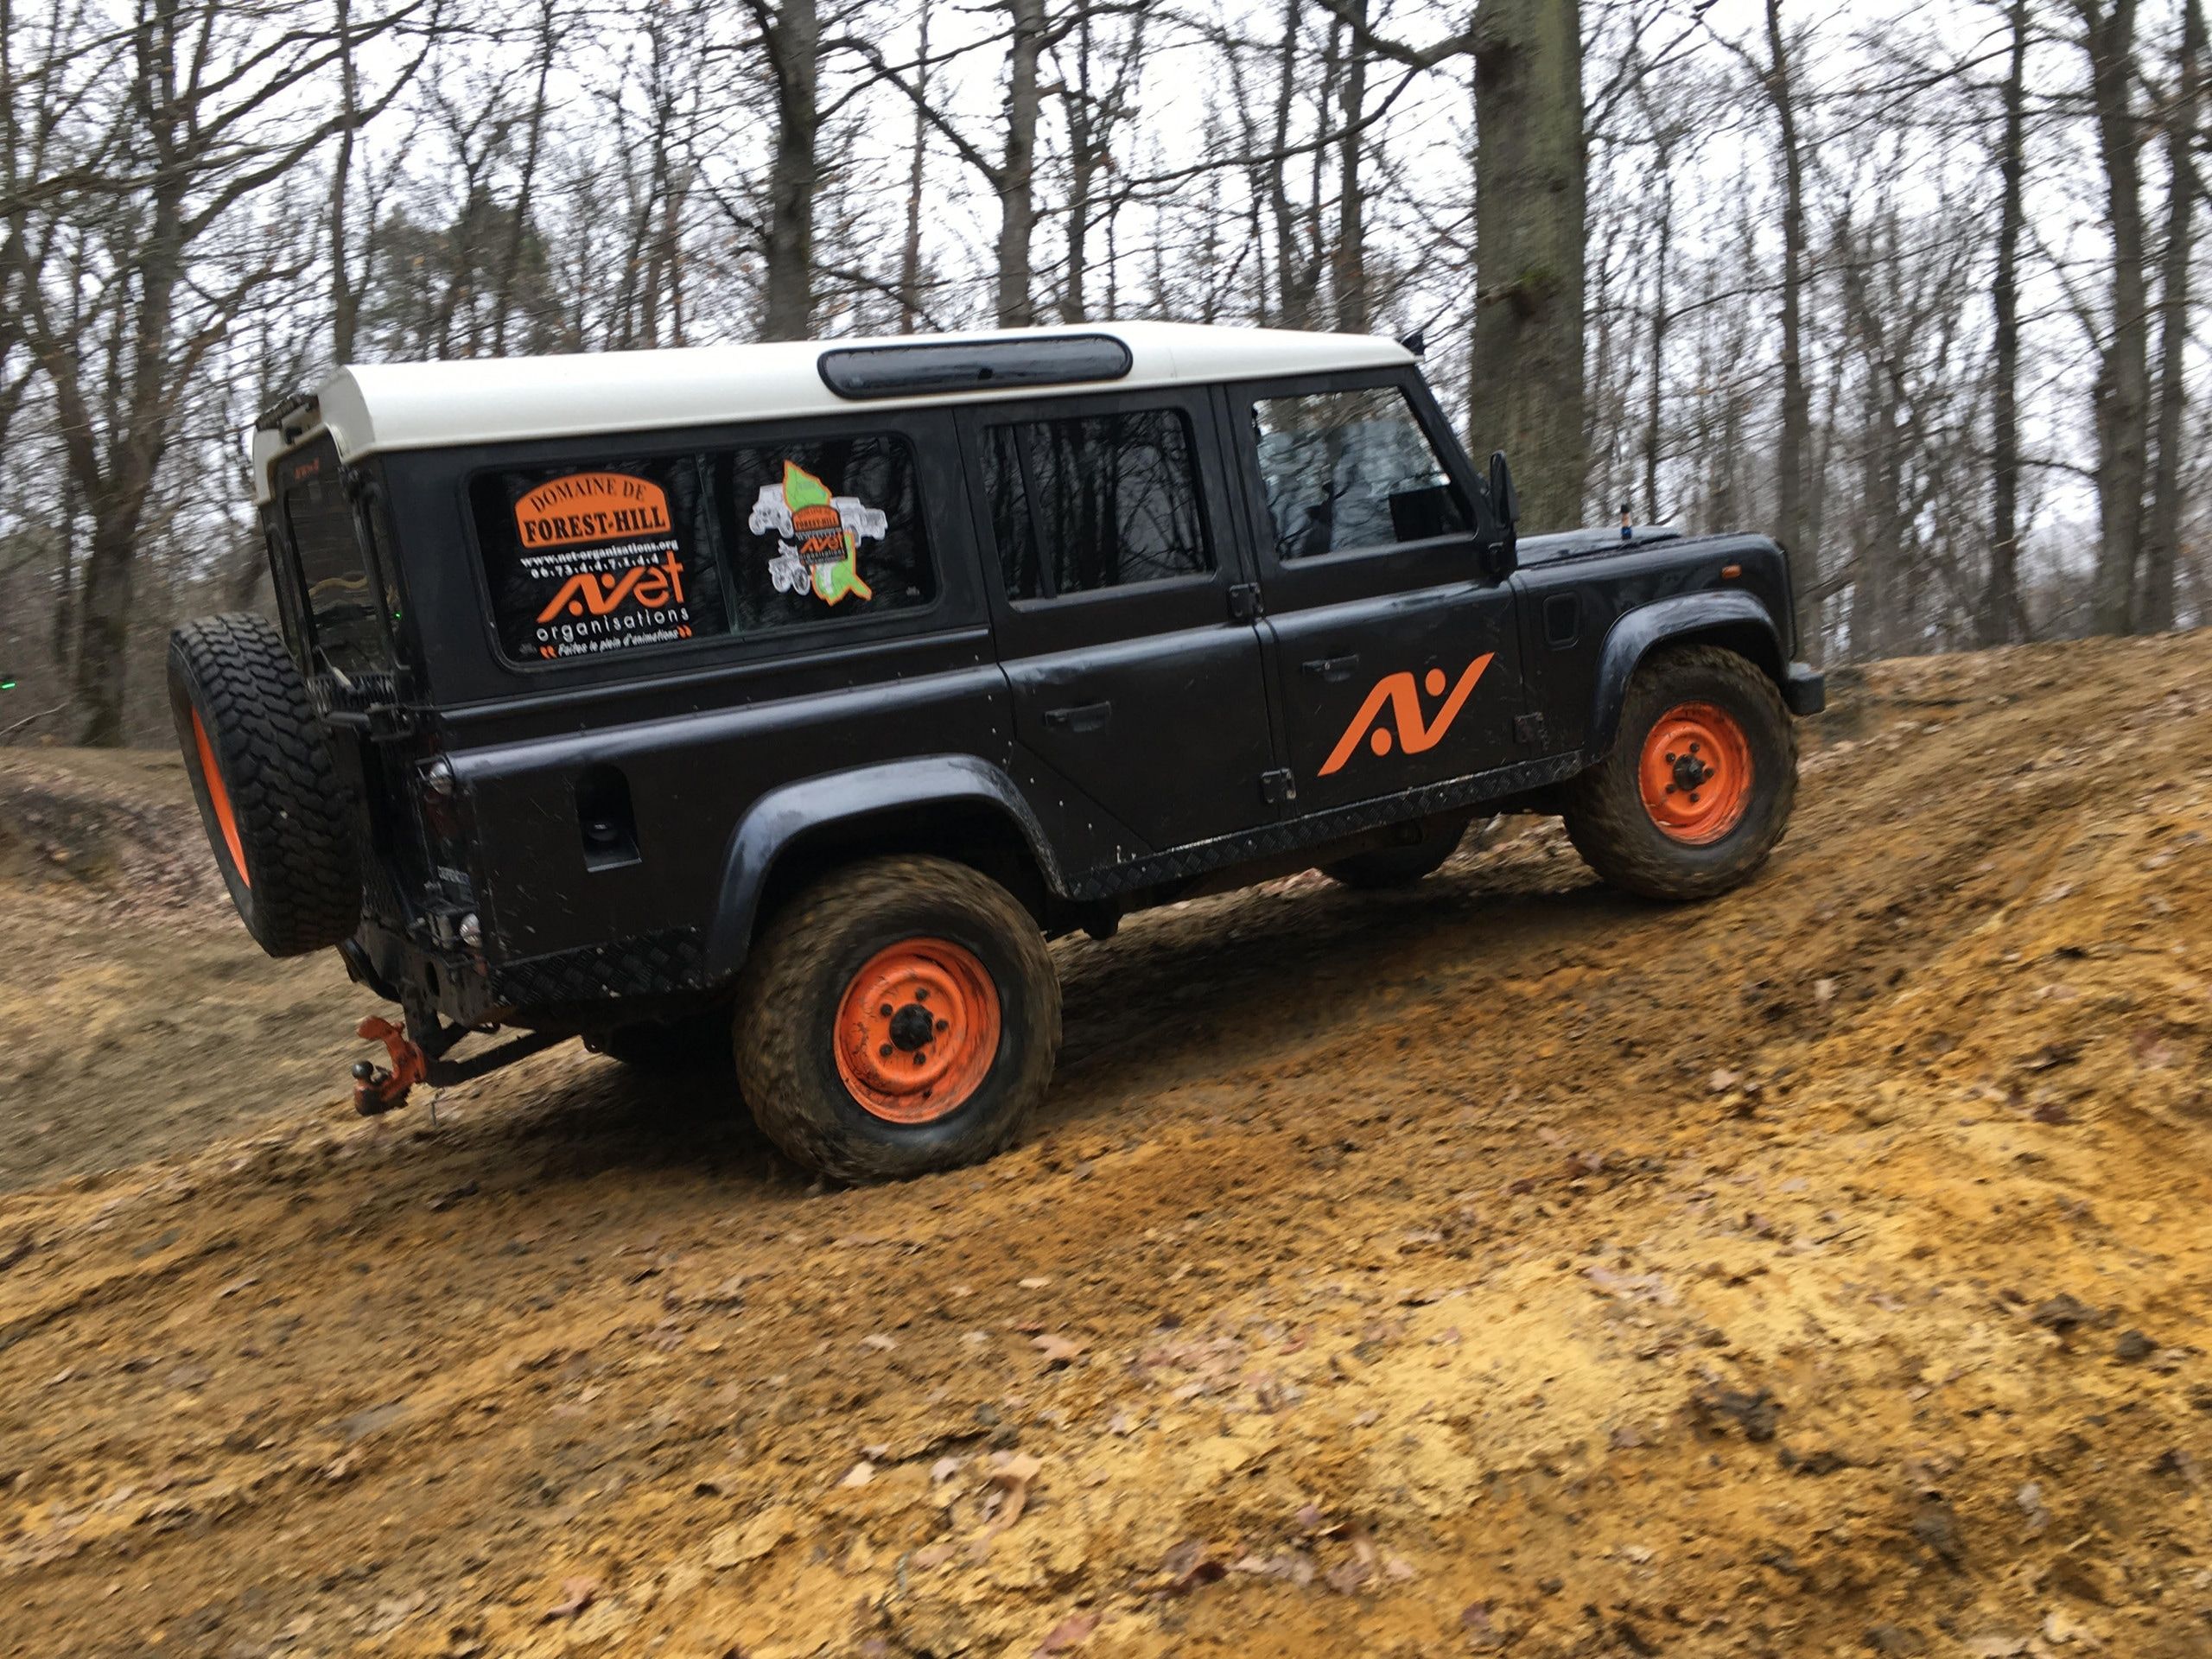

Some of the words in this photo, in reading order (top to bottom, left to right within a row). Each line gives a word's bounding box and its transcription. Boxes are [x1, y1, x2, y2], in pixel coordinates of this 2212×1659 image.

[531, 476, 617, 512] DOMAINE
[623, 480, 646, 500] DE
[524, 505, 664, 542] FOREST-HILL
[536, 608, 690, 642] organisations
